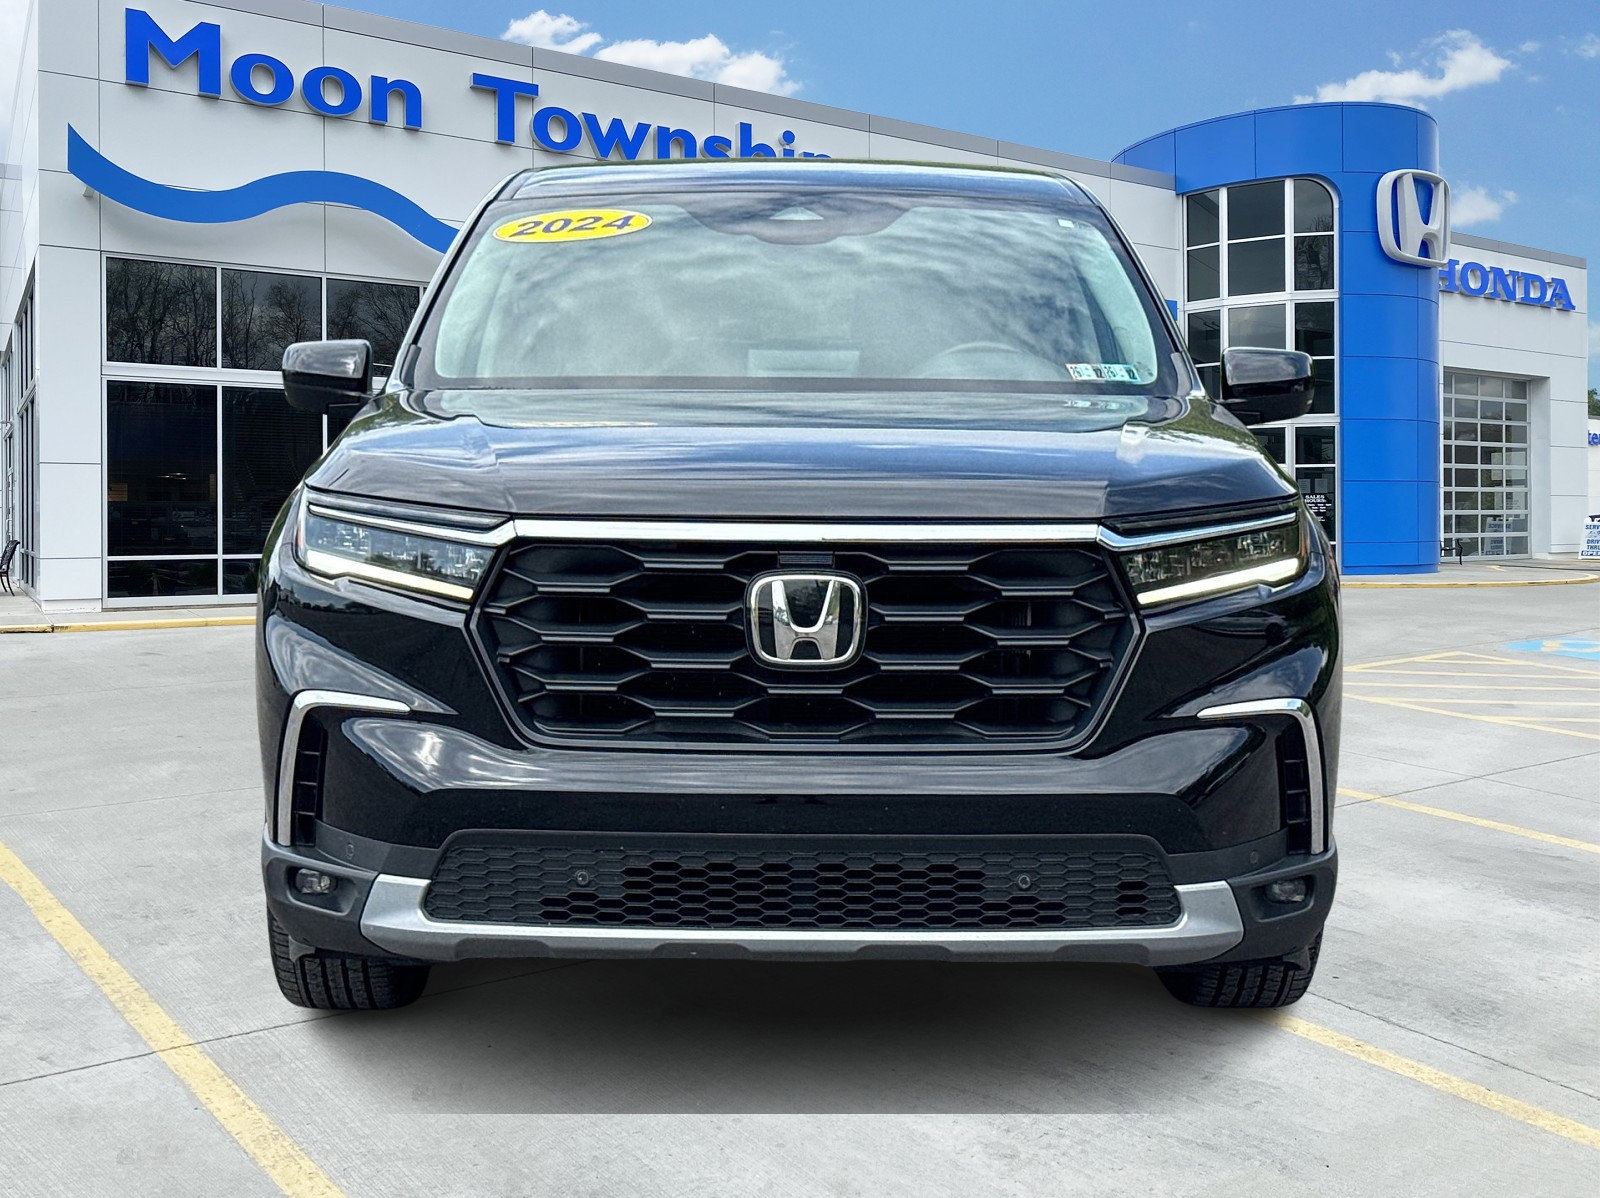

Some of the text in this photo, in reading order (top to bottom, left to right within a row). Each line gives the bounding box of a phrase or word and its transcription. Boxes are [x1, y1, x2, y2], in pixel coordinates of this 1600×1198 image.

[125, 7, 832, 161] Moon Townshi
[515, 215, 635, 237] 2024
[1438, 258, 1576, 311] HONDA
